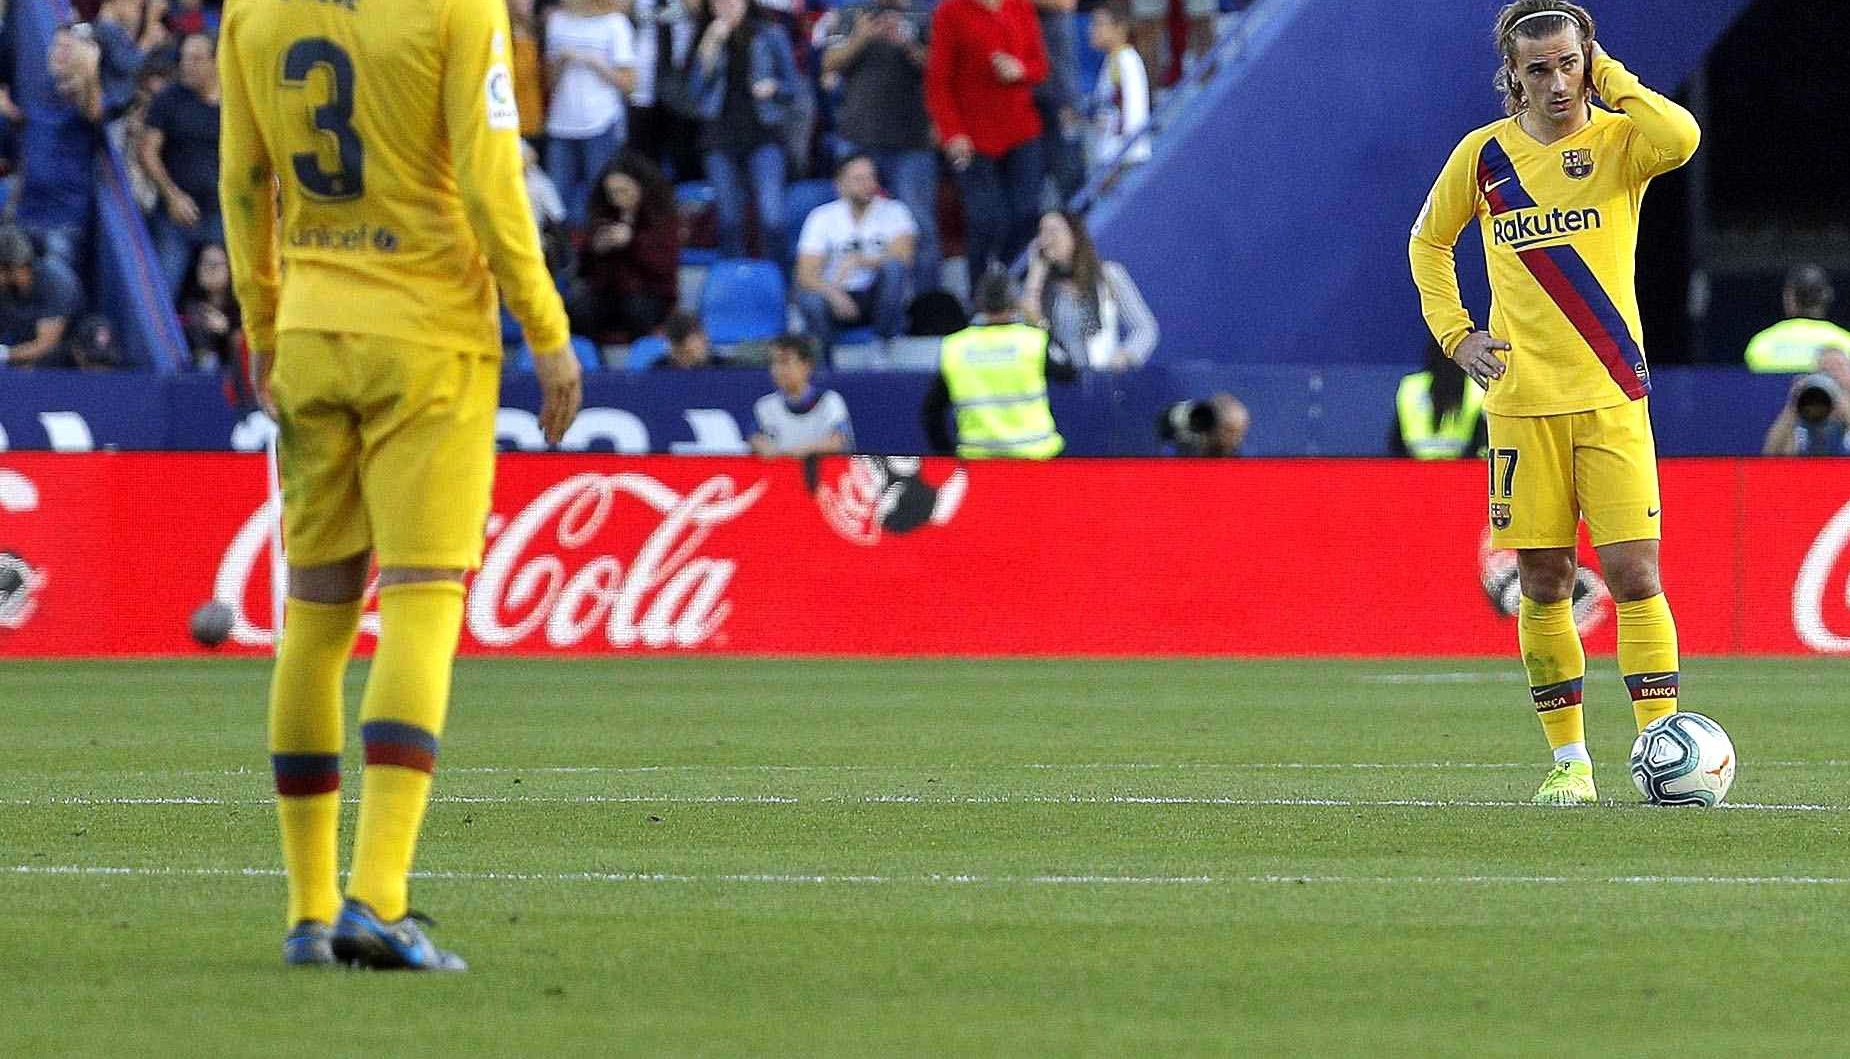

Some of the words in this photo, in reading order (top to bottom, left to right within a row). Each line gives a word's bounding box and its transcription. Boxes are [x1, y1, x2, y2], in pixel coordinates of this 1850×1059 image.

[281, 37, 365, 204] 3
[1493, 206, 1601, 245] Rakuten
[1488, 447, 1519, 497] 17
[1641, 686, 1676, 698] BARÇA
